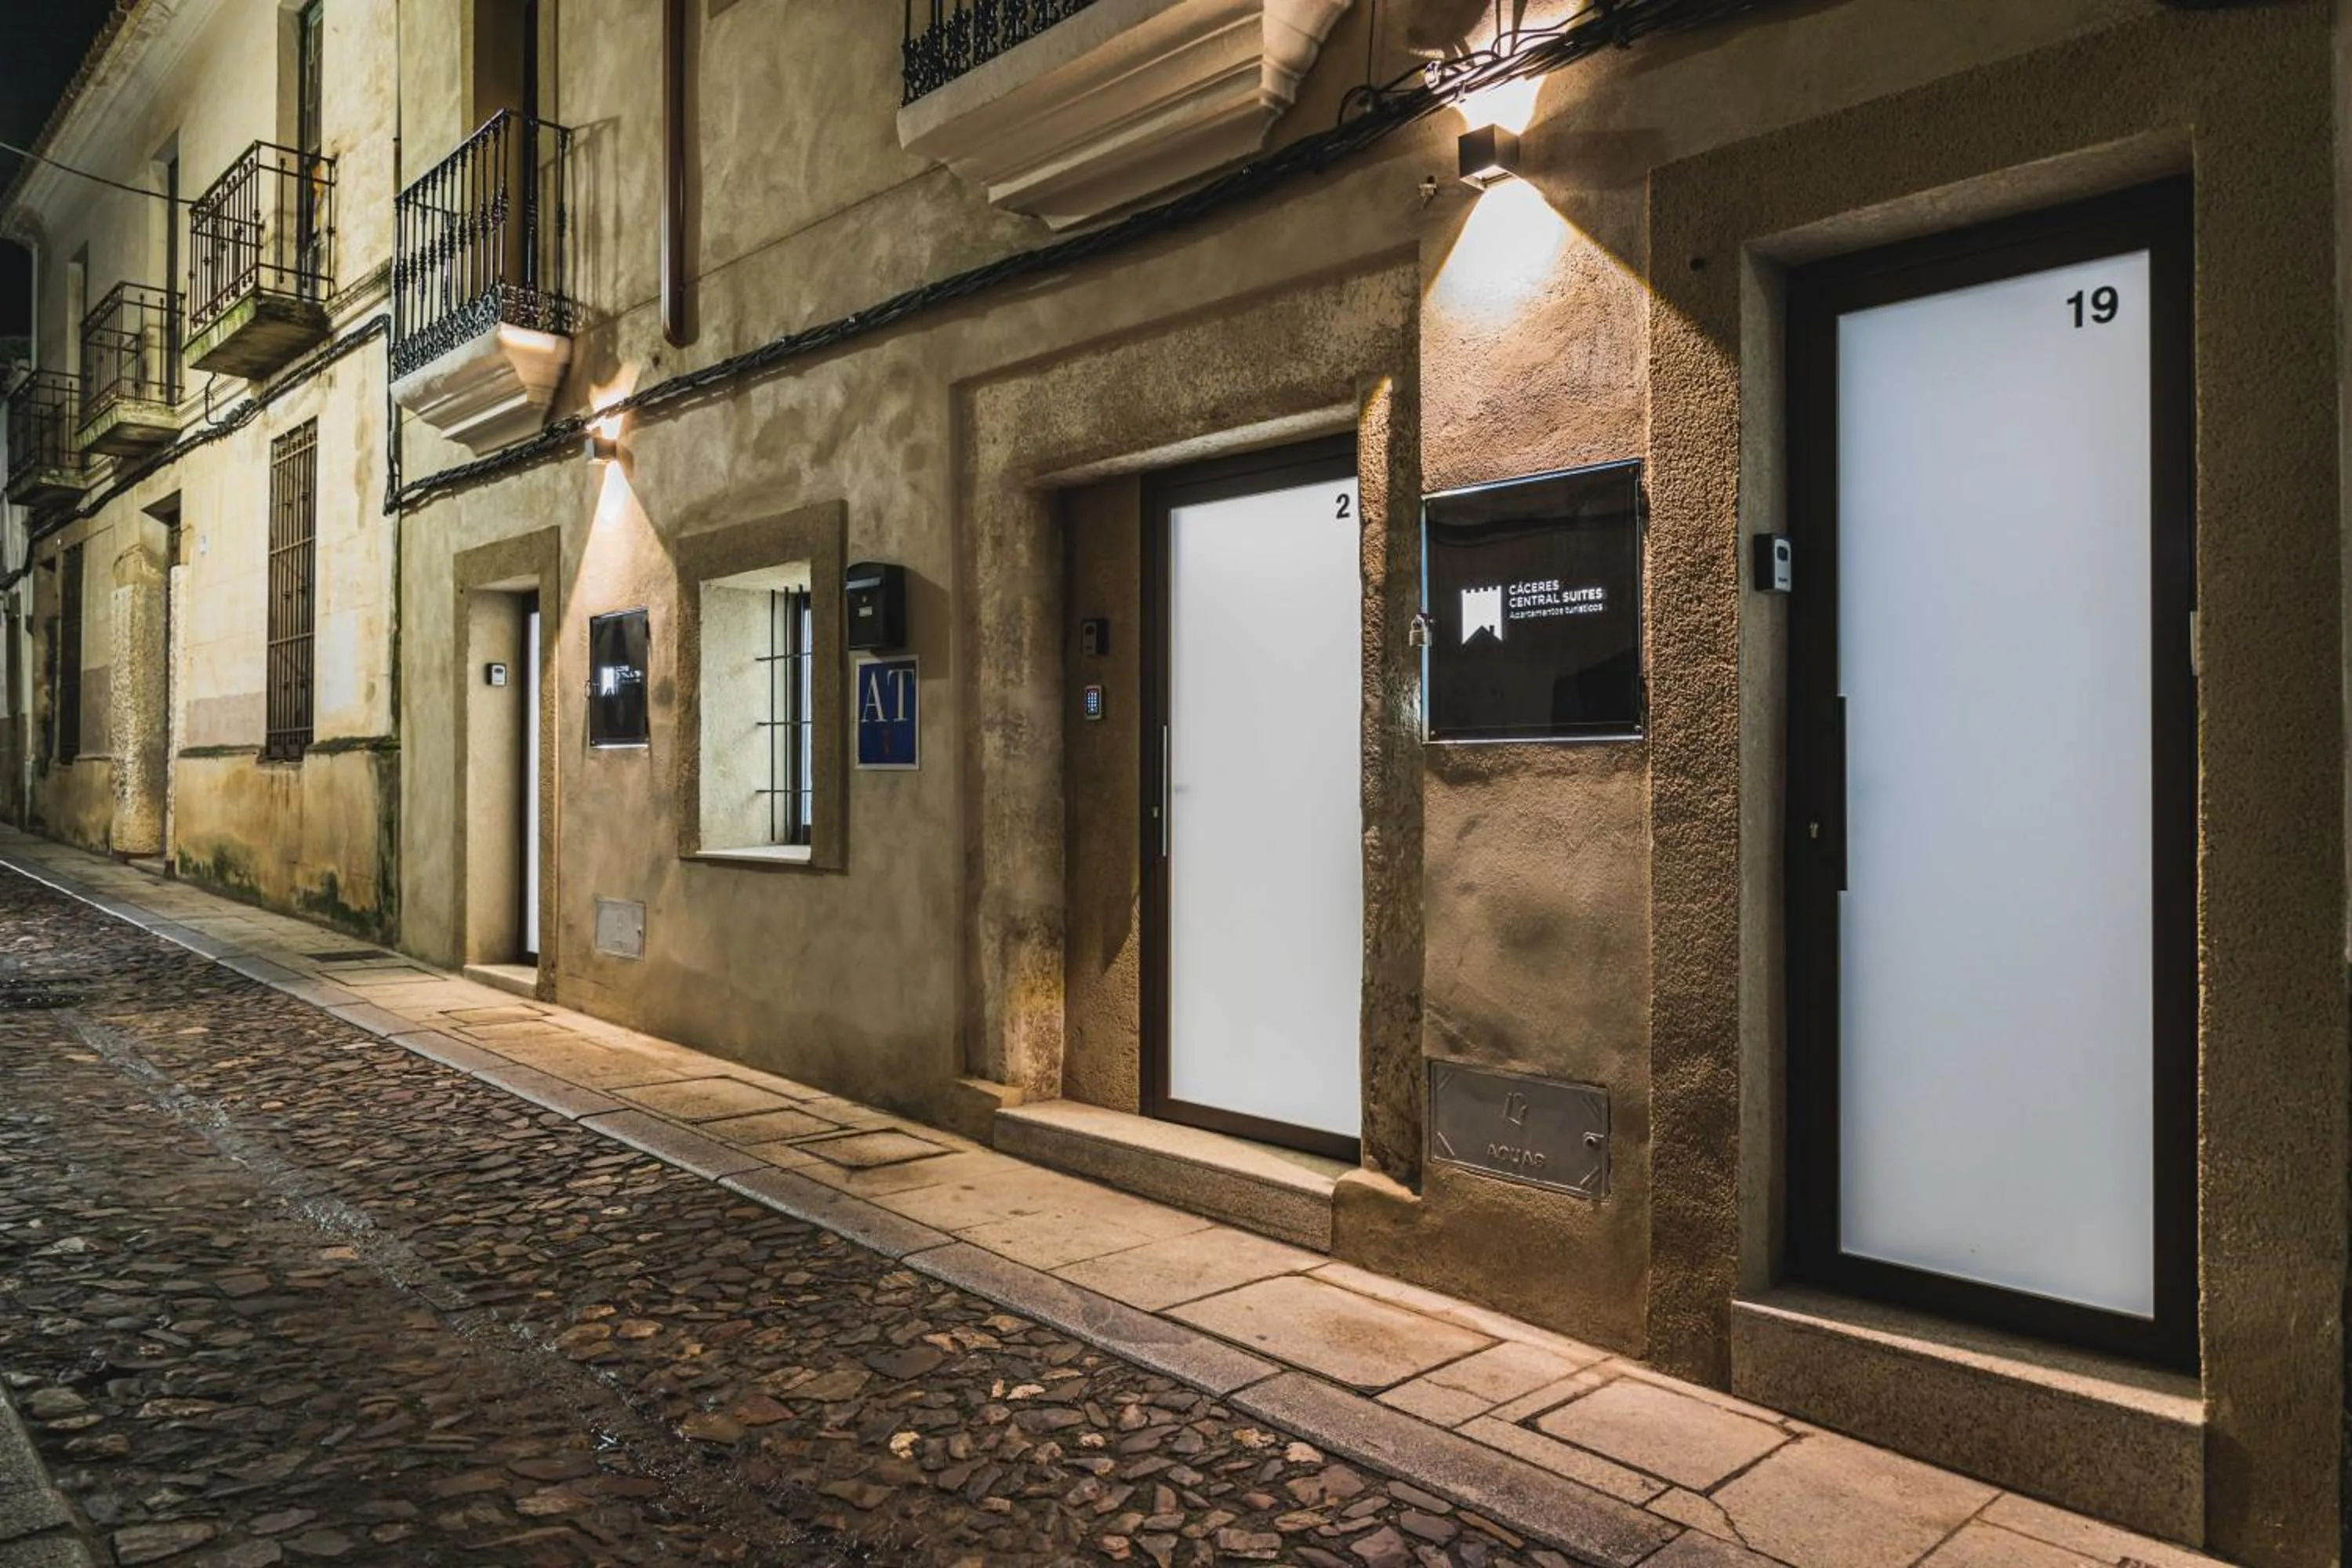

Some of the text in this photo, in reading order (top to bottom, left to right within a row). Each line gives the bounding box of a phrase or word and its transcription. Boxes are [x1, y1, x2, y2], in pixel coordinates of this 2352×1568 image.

[2067, 285, 2118, 328] 19
[1335, 493, 1351, 519] 2
[1508, 580, 1559, 595] CÁCERES
[1508, 587, 1603, 608] CENTRAL SUITES
[861, 669, 915, 723] AT
